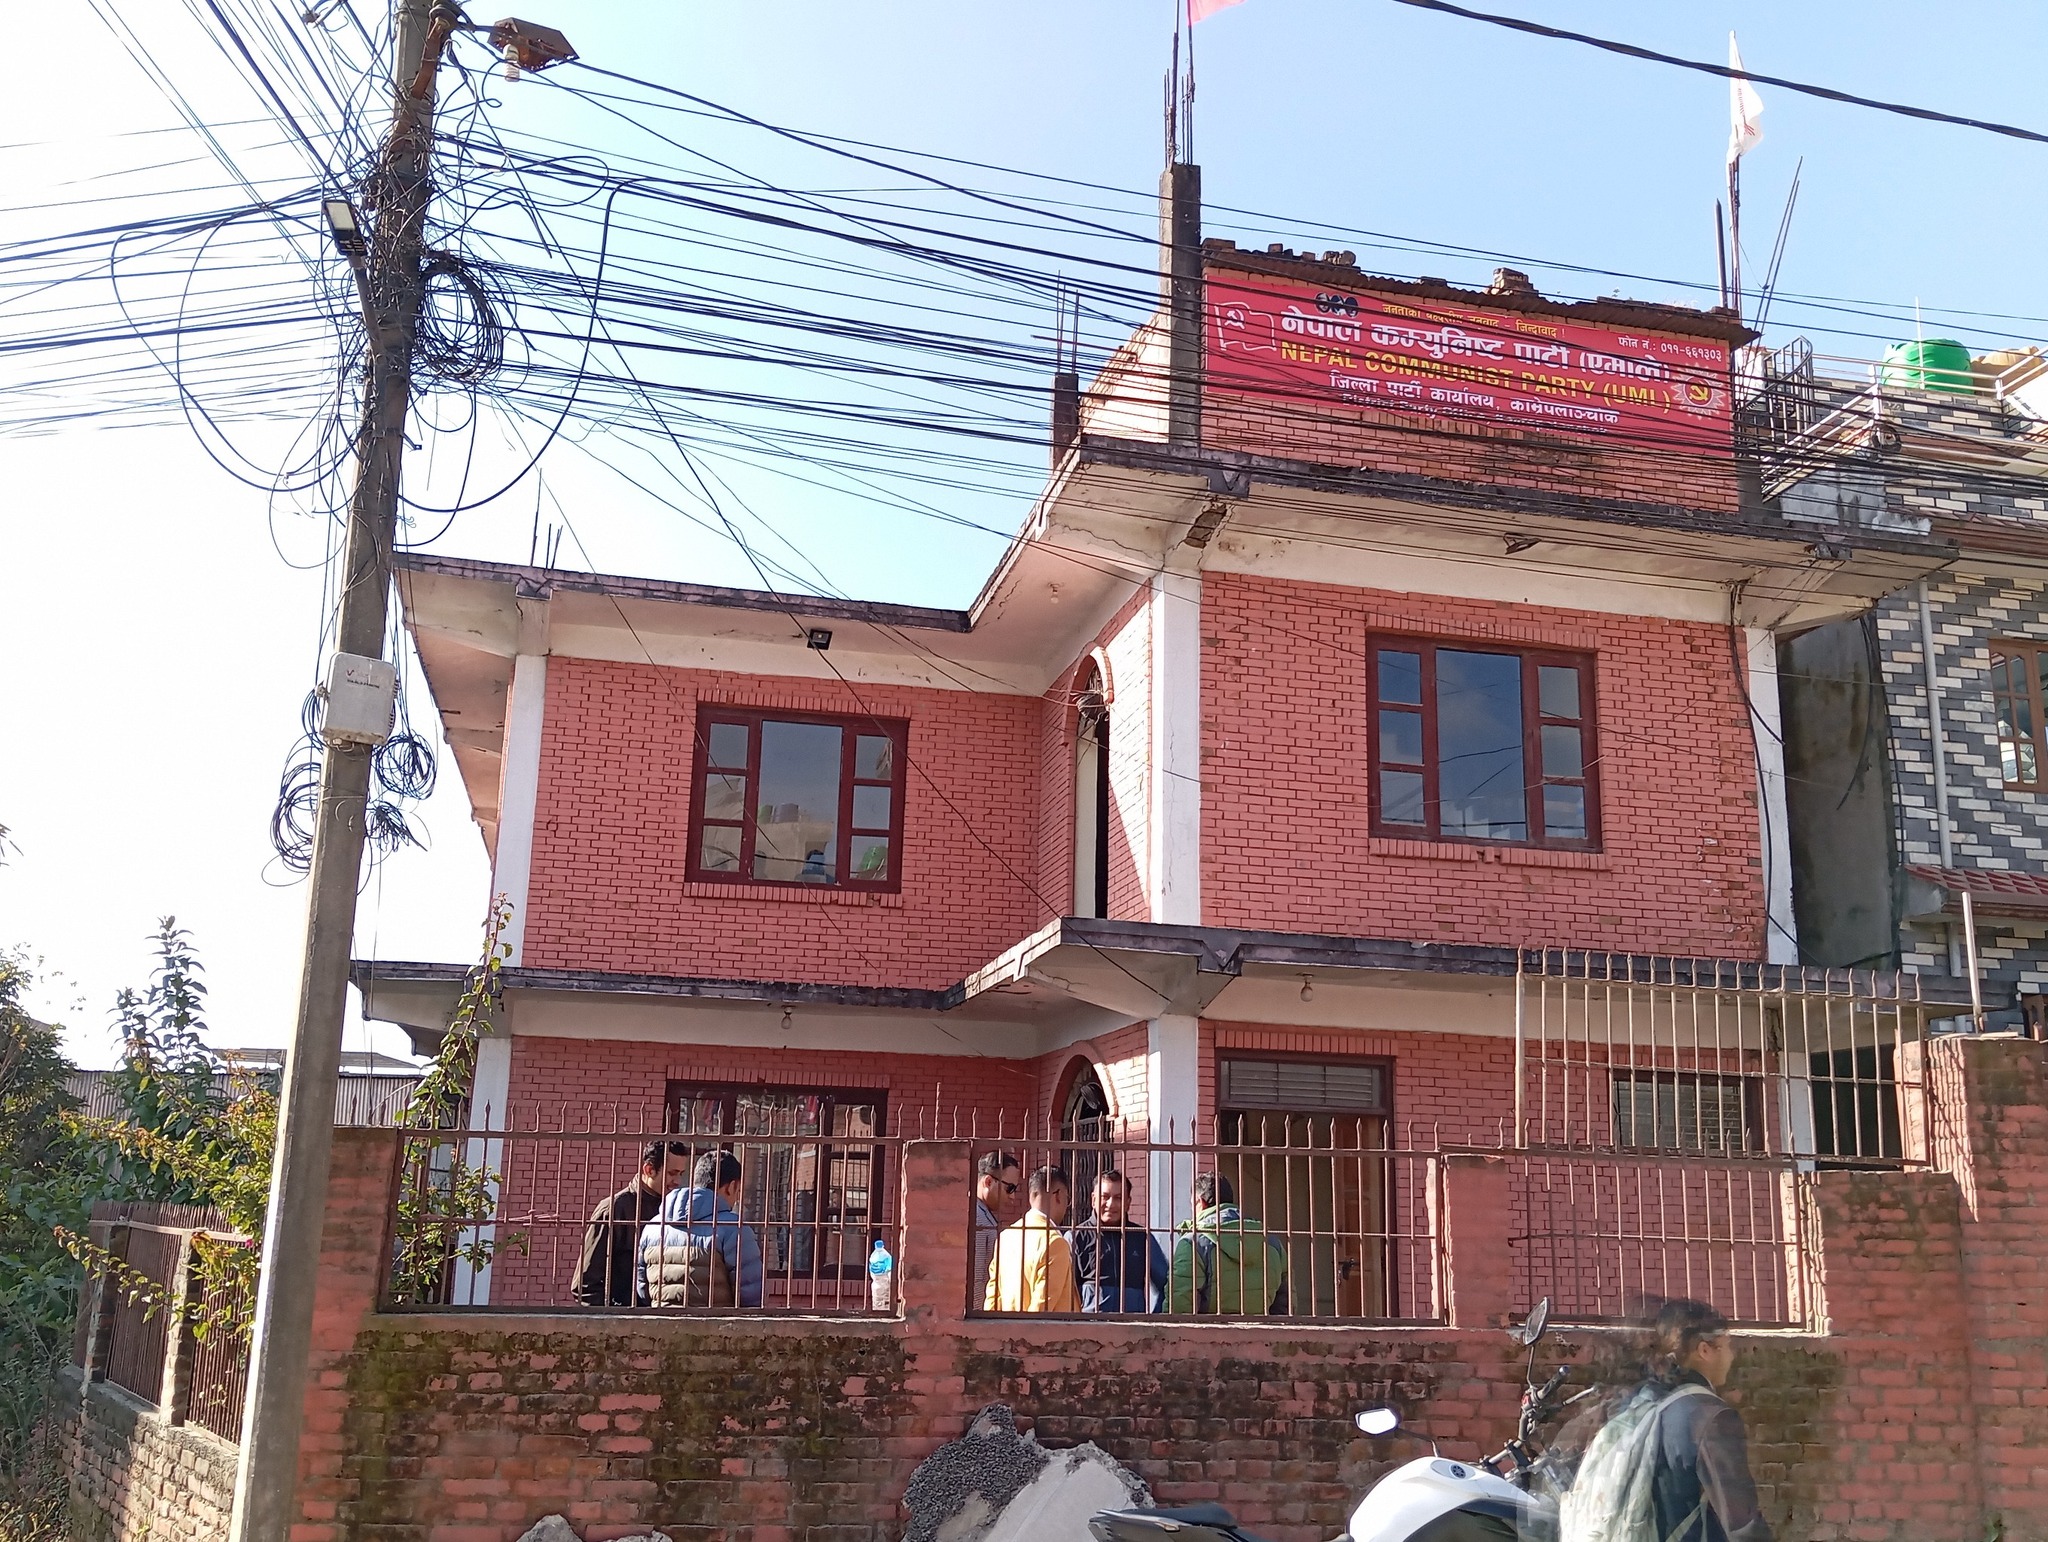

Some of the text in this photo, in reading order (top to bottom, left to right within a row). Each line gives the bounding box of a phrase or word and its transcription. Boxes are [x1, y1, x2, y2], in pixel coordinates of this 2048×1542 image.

[1281, 306, 1362, 342] नेपाल
[1281, 341, 1671, 414] NEPAL COMMUNIST PARTY (UML)
[1329, 369, 1379, 393] जिल्ला
